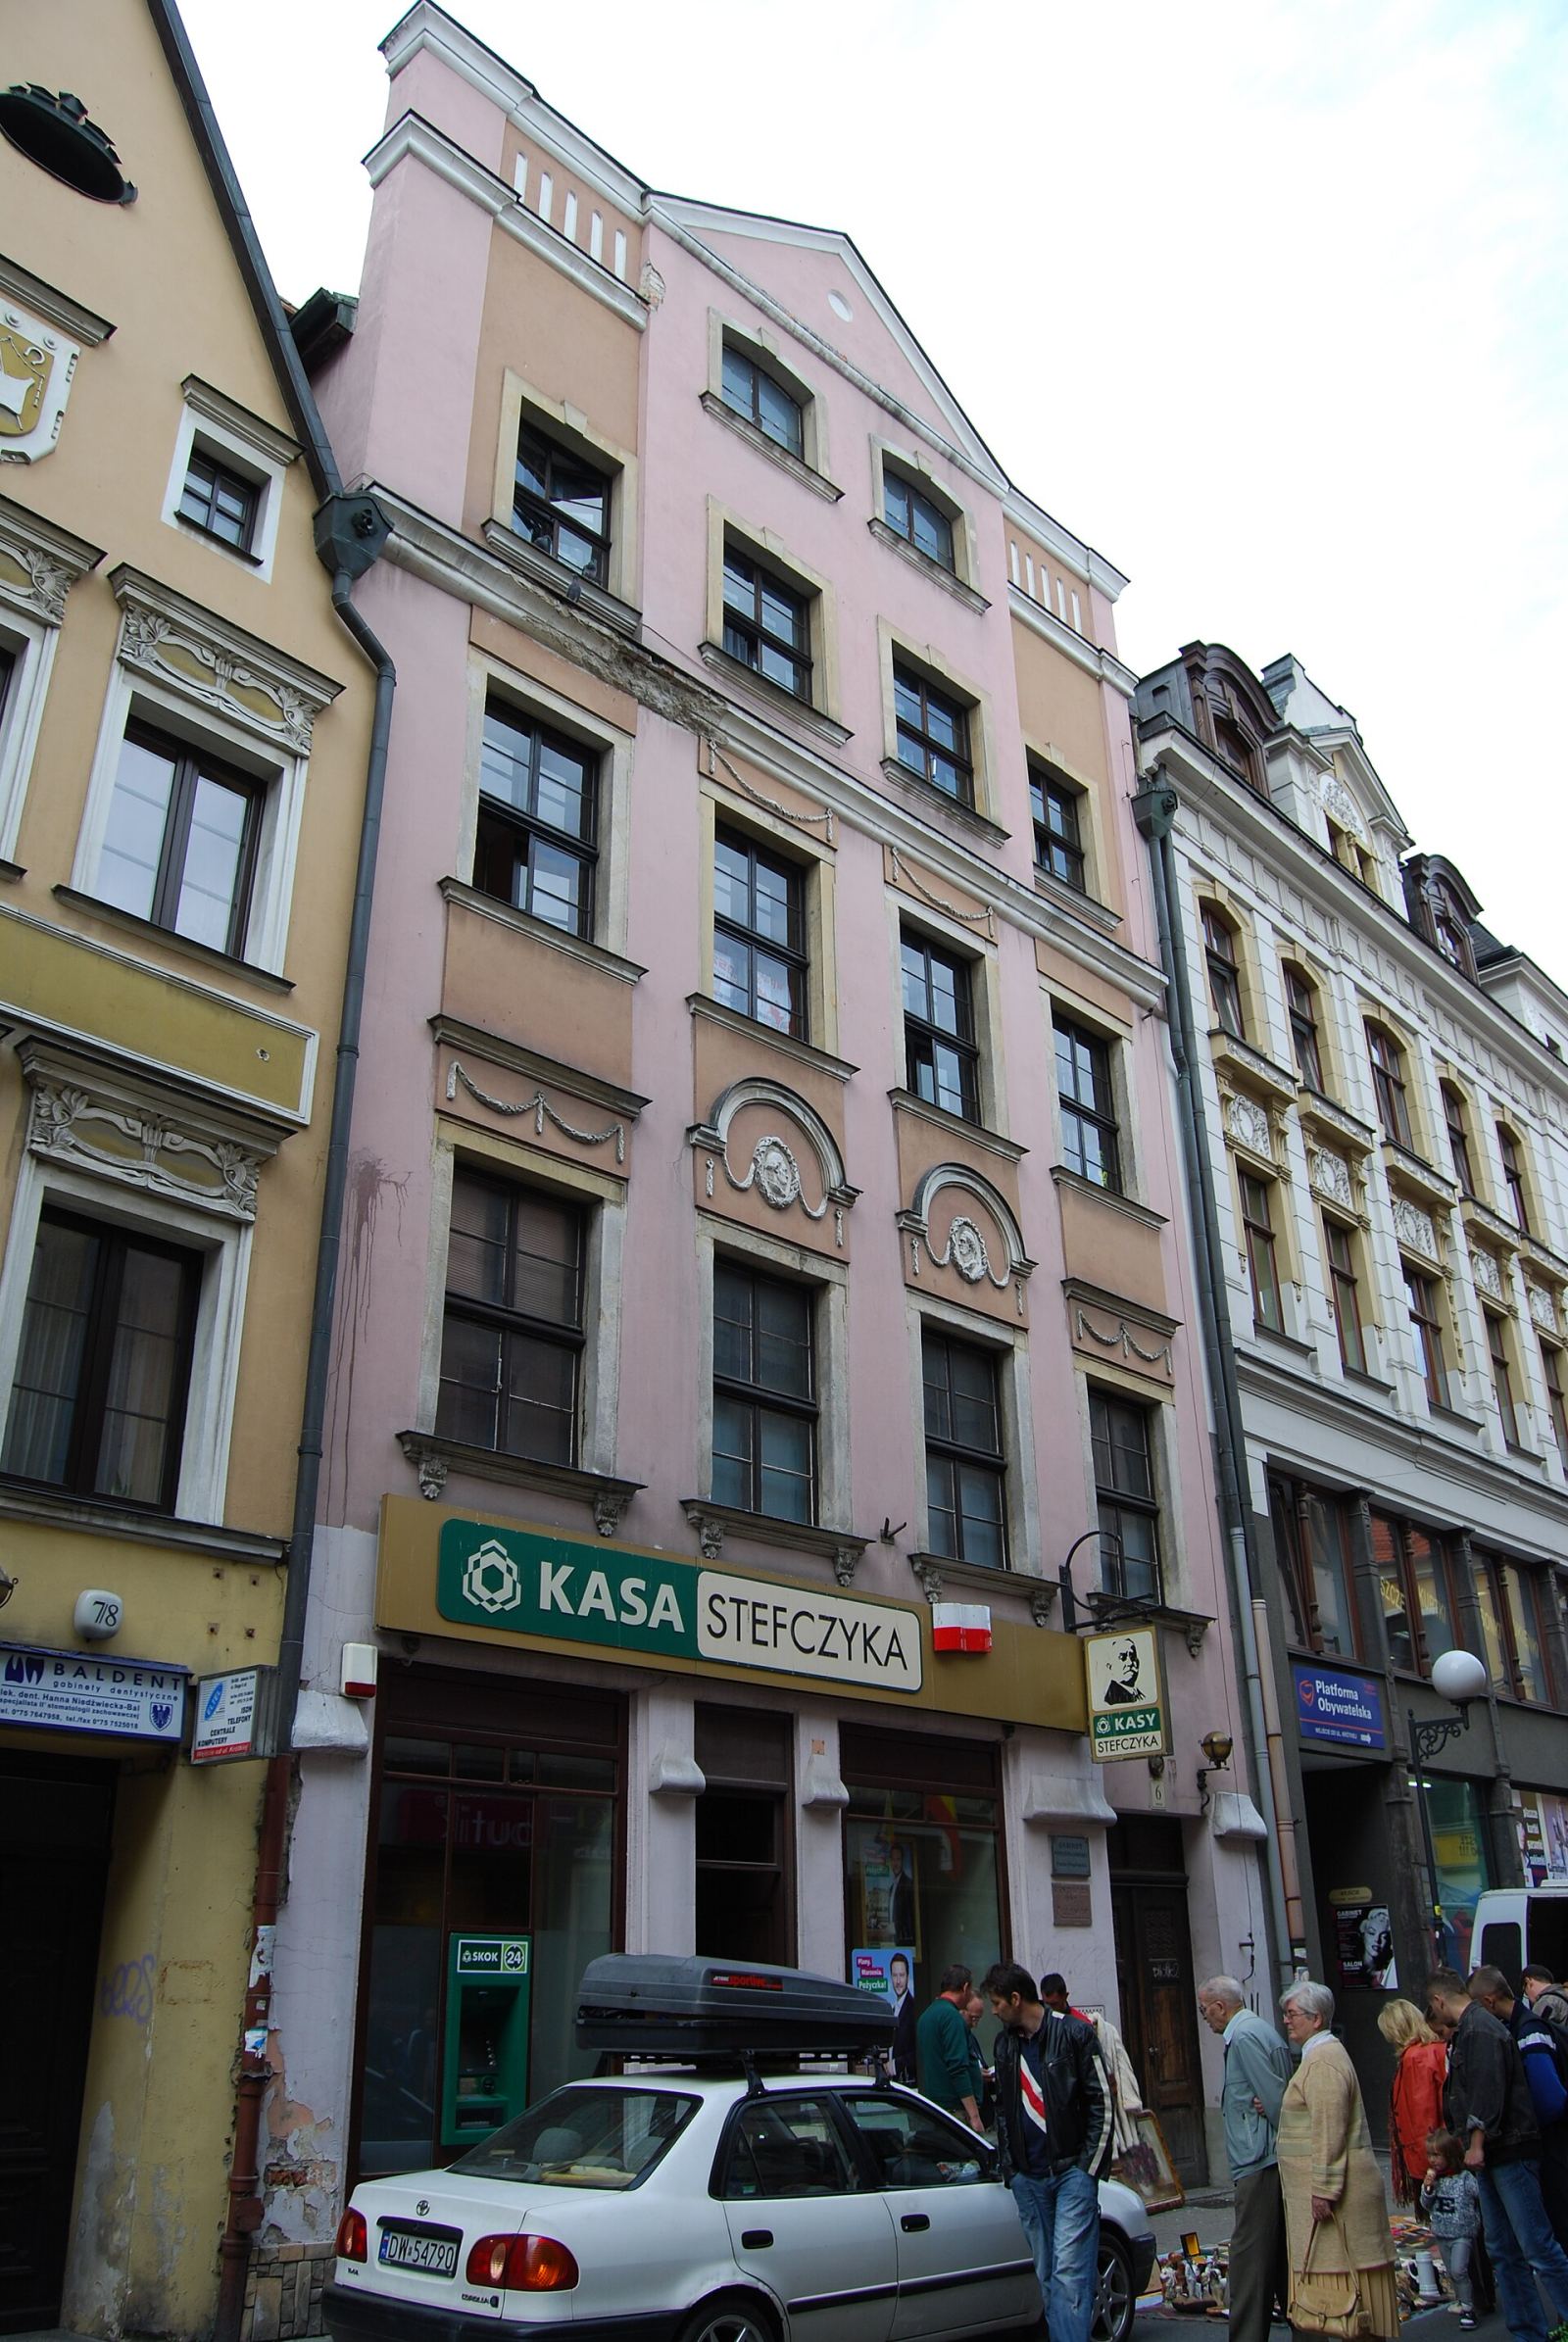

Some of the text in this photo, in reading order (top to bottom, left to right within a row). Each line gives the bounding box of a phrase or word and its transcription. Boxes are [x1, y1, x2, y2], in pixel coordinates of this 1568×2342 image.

[92, 1600, 120, 1628] 7/8
[539, 1561, 907, 1671] KASA STEFCZYKA
[54, 1663, 180, 1690] BALDENT
[19, 1691, 40, 1700] dent.
[43, 1693, 70, 1703] Hanna
[53, 1680, 178, 1701] gabinety dentystyczne
[1315, 1680, 1358, 1700] Platforma
[1318, 1697, 1372, 1720] Obywatelska
[227, 1715, 251, 1725] TELEFONY
[1114, 1713, 1155, 1731] KASY
[210, 1727, 235, 1736] CENTRALE
[1098, 1734, 1158, 1752] STEFCZYKA
[1154, 1784, 1162, 1801] 6
[472, 1951, 521, 1964] SKOK 24
